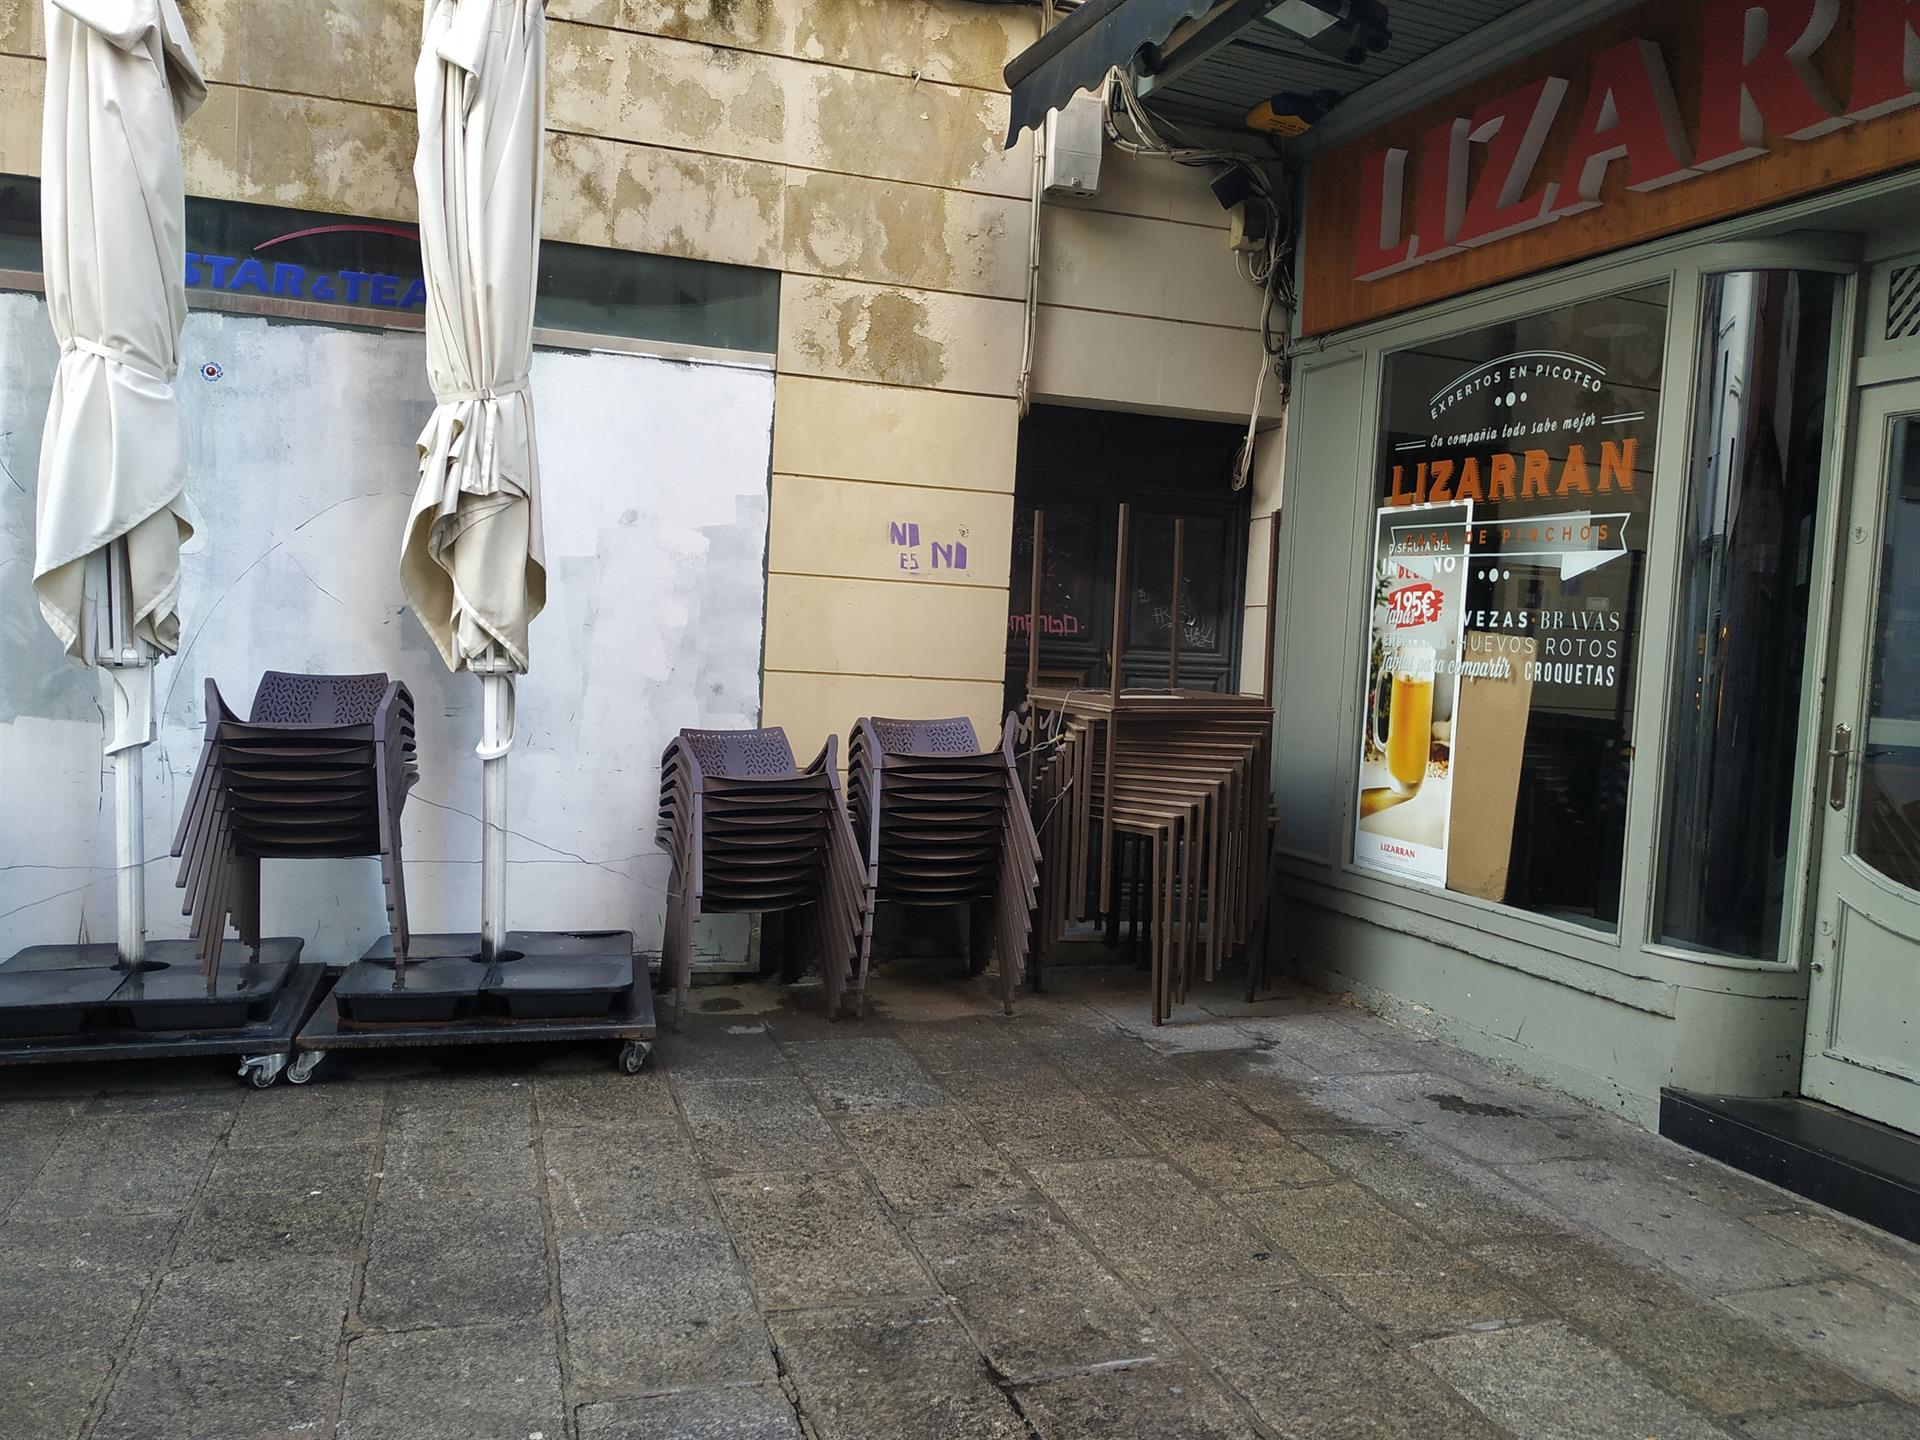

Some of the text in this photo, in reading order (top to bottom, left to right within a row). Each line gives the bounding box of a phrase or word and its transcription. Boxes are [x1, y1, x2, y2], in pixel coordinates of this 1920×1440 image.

[1430, 364, 1601, 420] EXPERTOS EN PICOTEO
[1430, 434, 1444, 448] En
[1502, 423, 1526, 438] todo
[1531, 417, 1557, 434] sabe
[1563, 412, 1597, 433] mejor
[1391, 438, 1639, 507] LIZARRAN
[1464, 529, 1488, 545] DE
[1501, 523, 1609, 545] PINCHOS
[1389, 540, 1452, 554] DISFRUTA DEL
[1541, 611, 1620, 632] BRAVAS
[1459, 634, 1535, 654] HUEVOS
[1545, 638, 1618, 659] ROTOS
[1447, 656, 1511, 682] compartir
[1524, 661, 1615, 687] CROQUETAS
[1380, 842, 1416, 858] LIZARRAN
